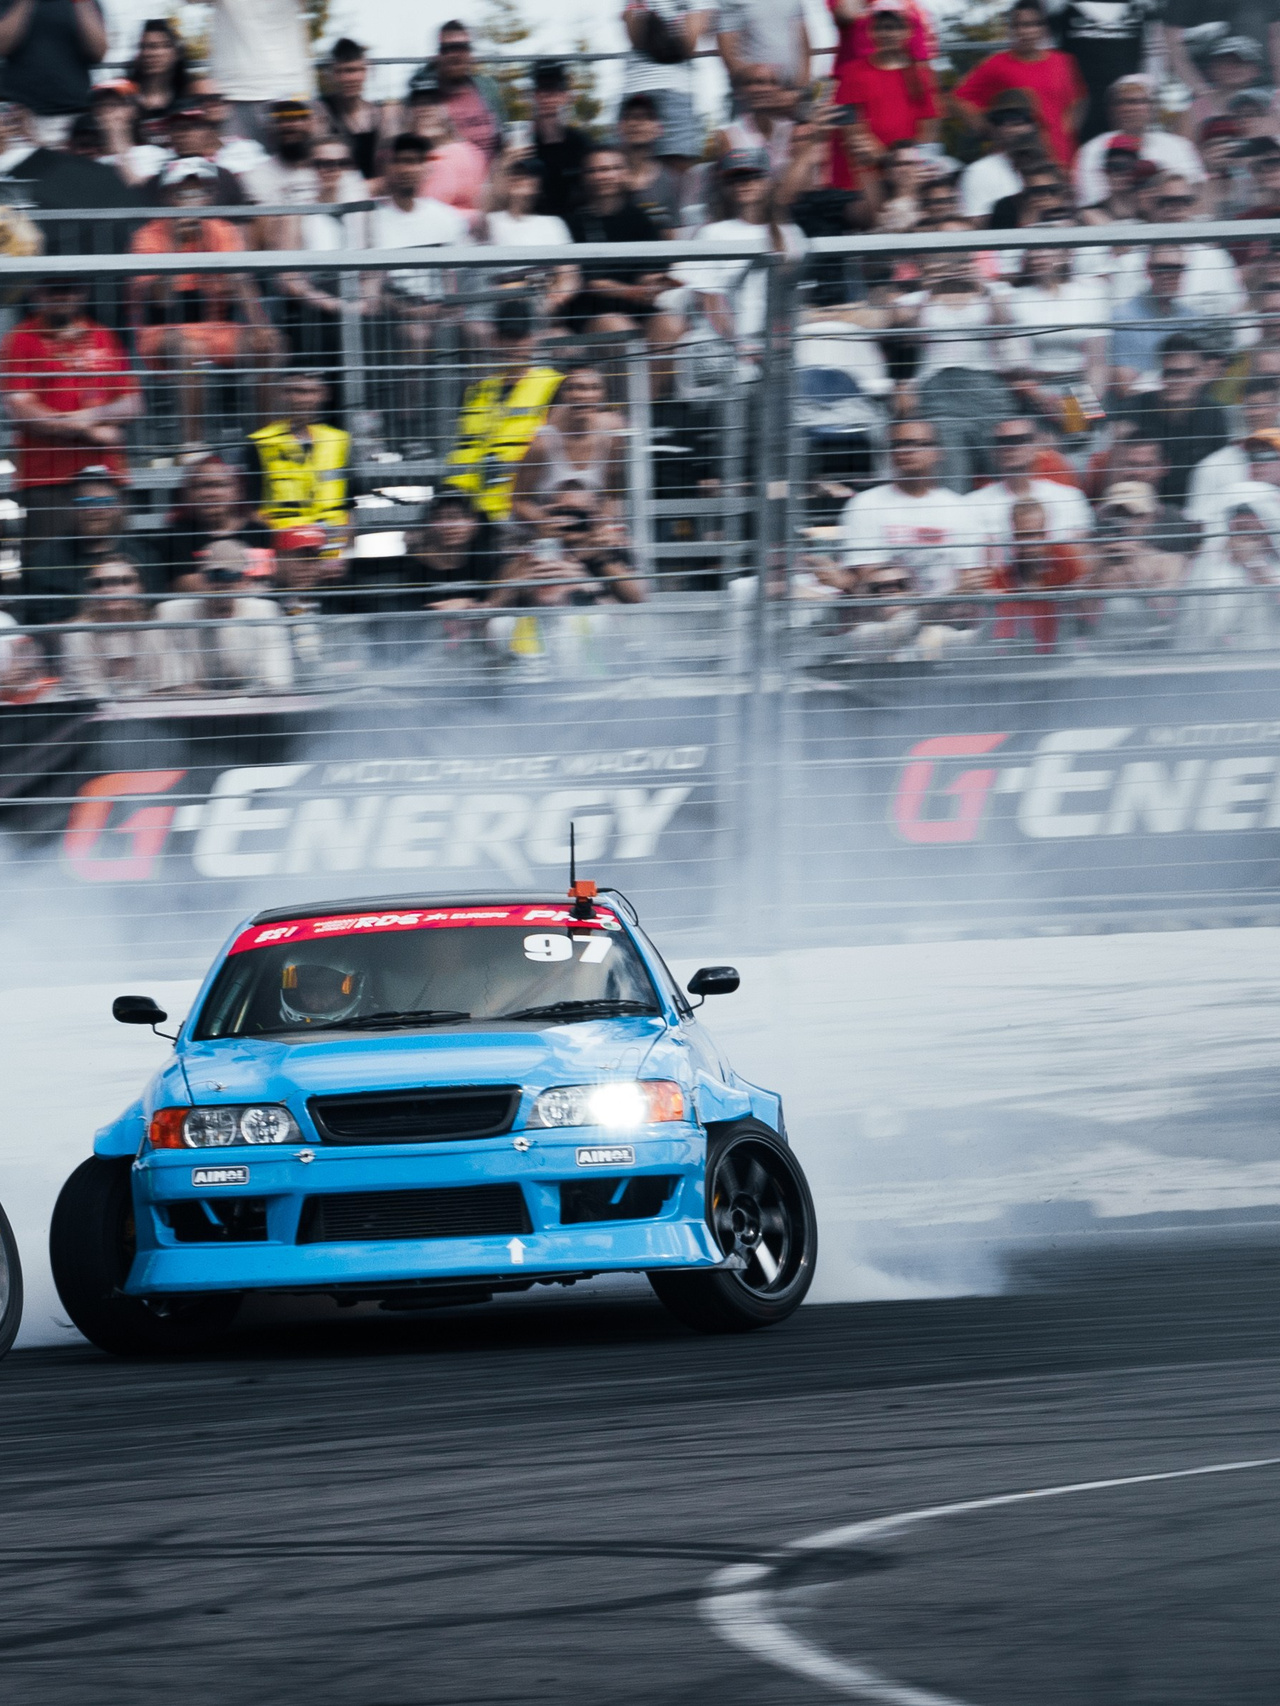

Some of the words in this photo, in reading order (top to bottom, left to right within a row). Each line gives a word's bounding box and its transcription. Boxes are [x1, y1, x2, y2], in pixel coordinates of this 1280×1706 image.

[892, 727, 1280, 843] G-ENE
[354, 913, 423, 929] RDS
[523, 933, 613, 964] 97
